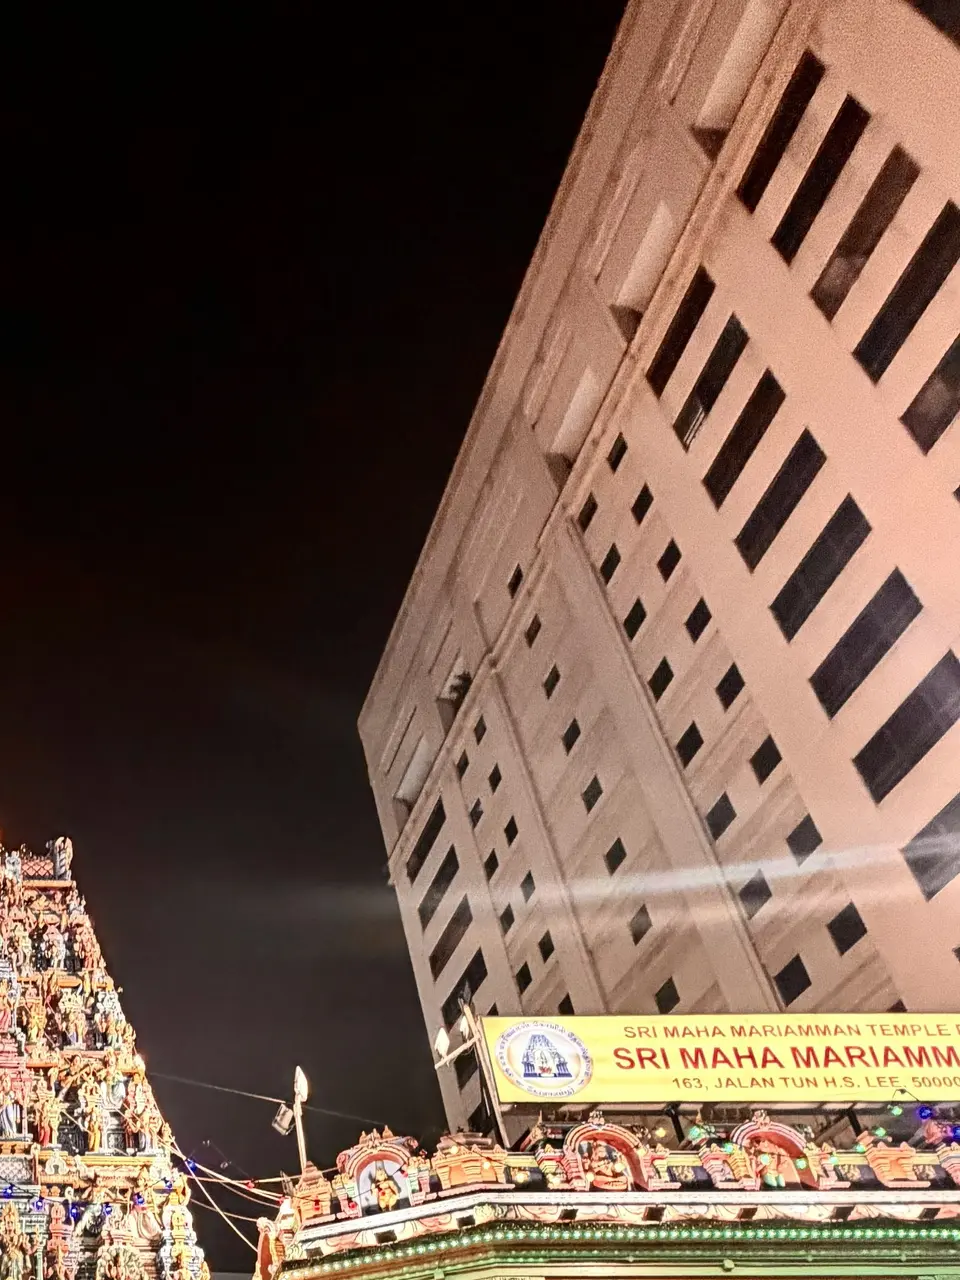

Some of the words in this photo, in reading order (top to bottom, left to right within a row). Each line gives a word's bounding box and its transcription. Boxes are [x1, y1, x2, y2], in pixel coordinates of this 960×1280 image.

[623, 1025, 658, 1039] SRI
[662, 1025, 727, 1039] MAHA
[729, 1023, 862, 1038] MARIAMMAN
[865, 1023, 952, 1037] TEMPLE
[612, 1046, 671, 1070] SRI
[678, 1045, 786, 1070] MAHA
[671, 1077, 709, 1091] 163,
[714, 1076, 776, 1089] JALAN
[778, 1076, 819, 1089] TUN
